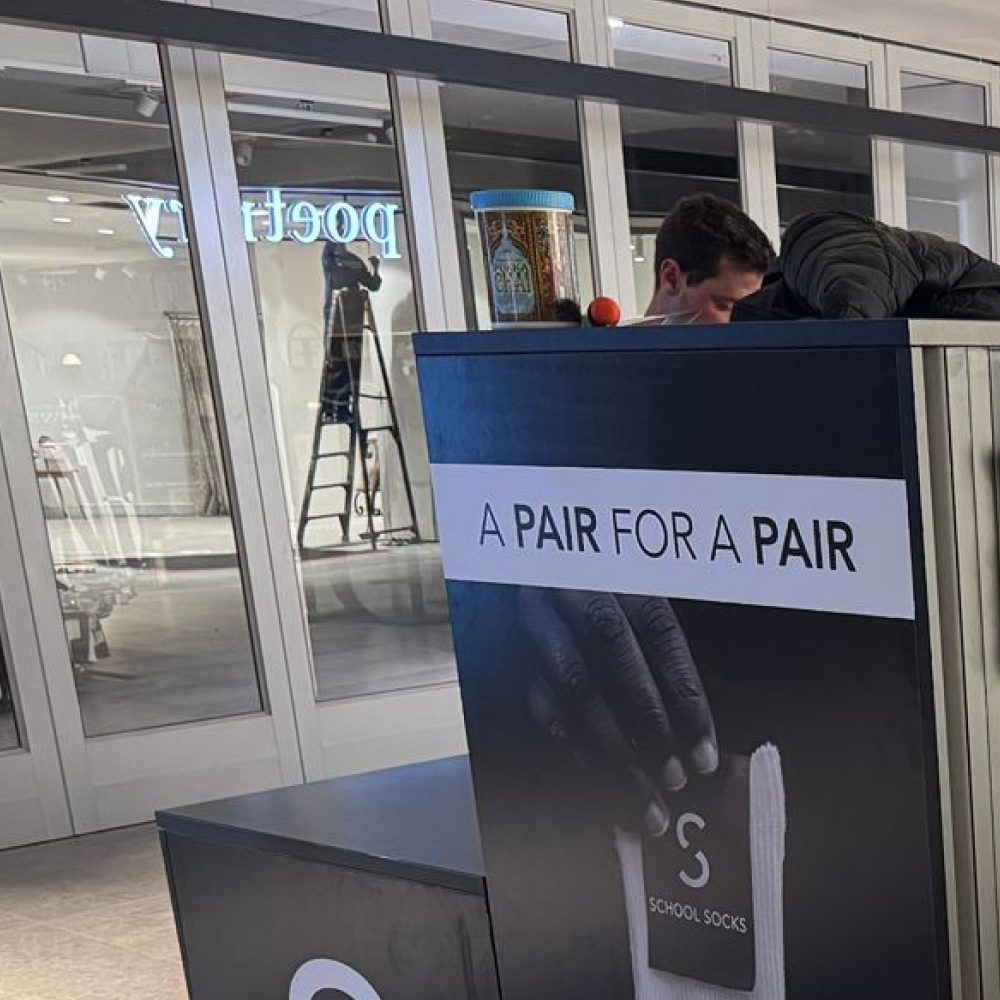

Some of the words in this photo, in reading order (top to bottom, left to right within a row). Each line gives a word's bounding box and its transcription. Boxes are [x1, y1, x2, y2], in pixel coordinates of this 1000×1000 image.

[479, 501, 506, 548] A
[513, 503, 602, 554] PAIR
[612, 507, 698, 562] FOR
[710, 513, 743, 564] A
[753, 515, 857, 573] PAIR
[648, 896, 701, 923] SCHOOL
[703, 907, 748, 934] SOCKS
